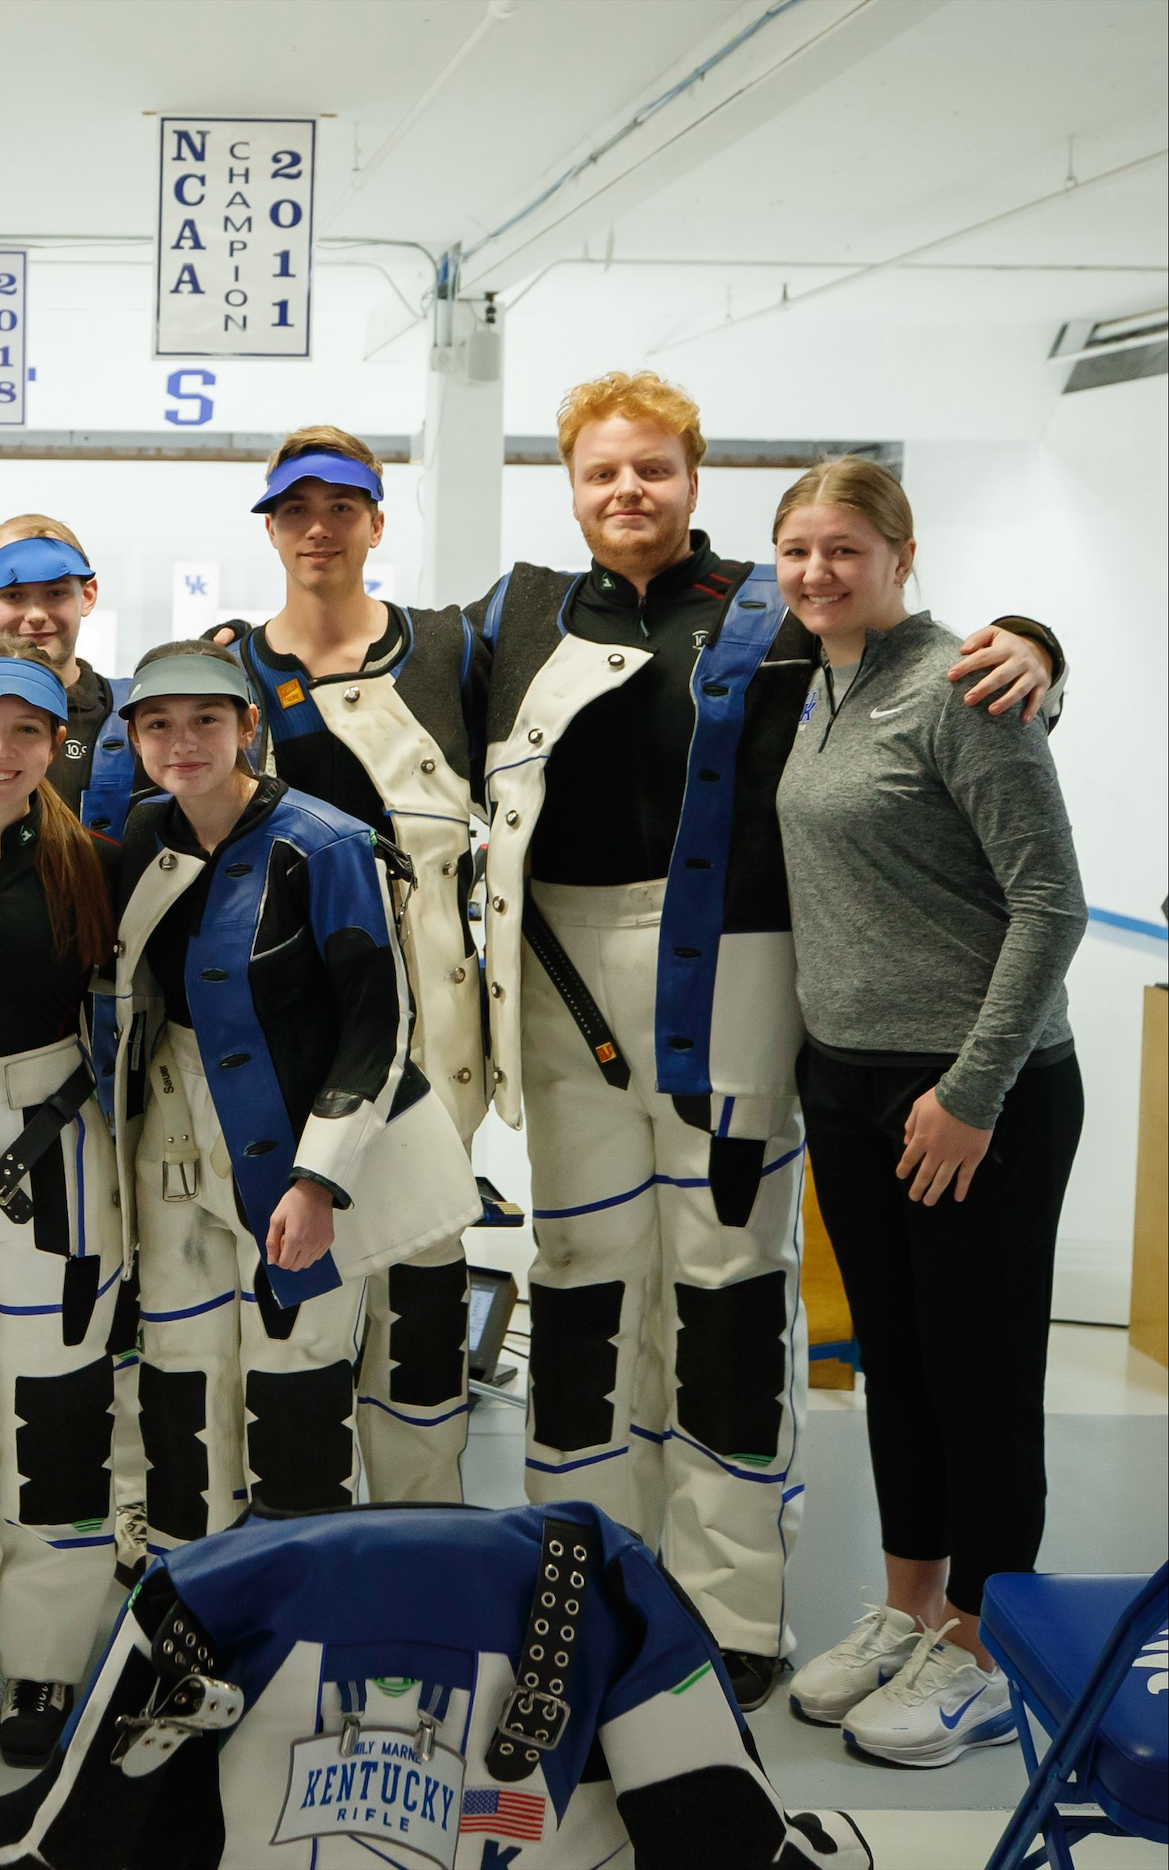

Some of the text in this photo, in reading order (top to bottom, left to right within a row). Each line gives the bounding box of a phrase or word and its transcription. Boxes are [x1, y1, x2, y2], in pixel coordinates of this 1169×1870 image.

[169, 130, 211, 294] NCAA
[223, 141, 252, 332] CHAMPION
[269, 150, 303, 327] 2011
[159, 1065, 174, 1094] Sauer
[300, 1760, 454, 1832] KENTUCKY
[337, 1807, 410, 1833] RIFLE
